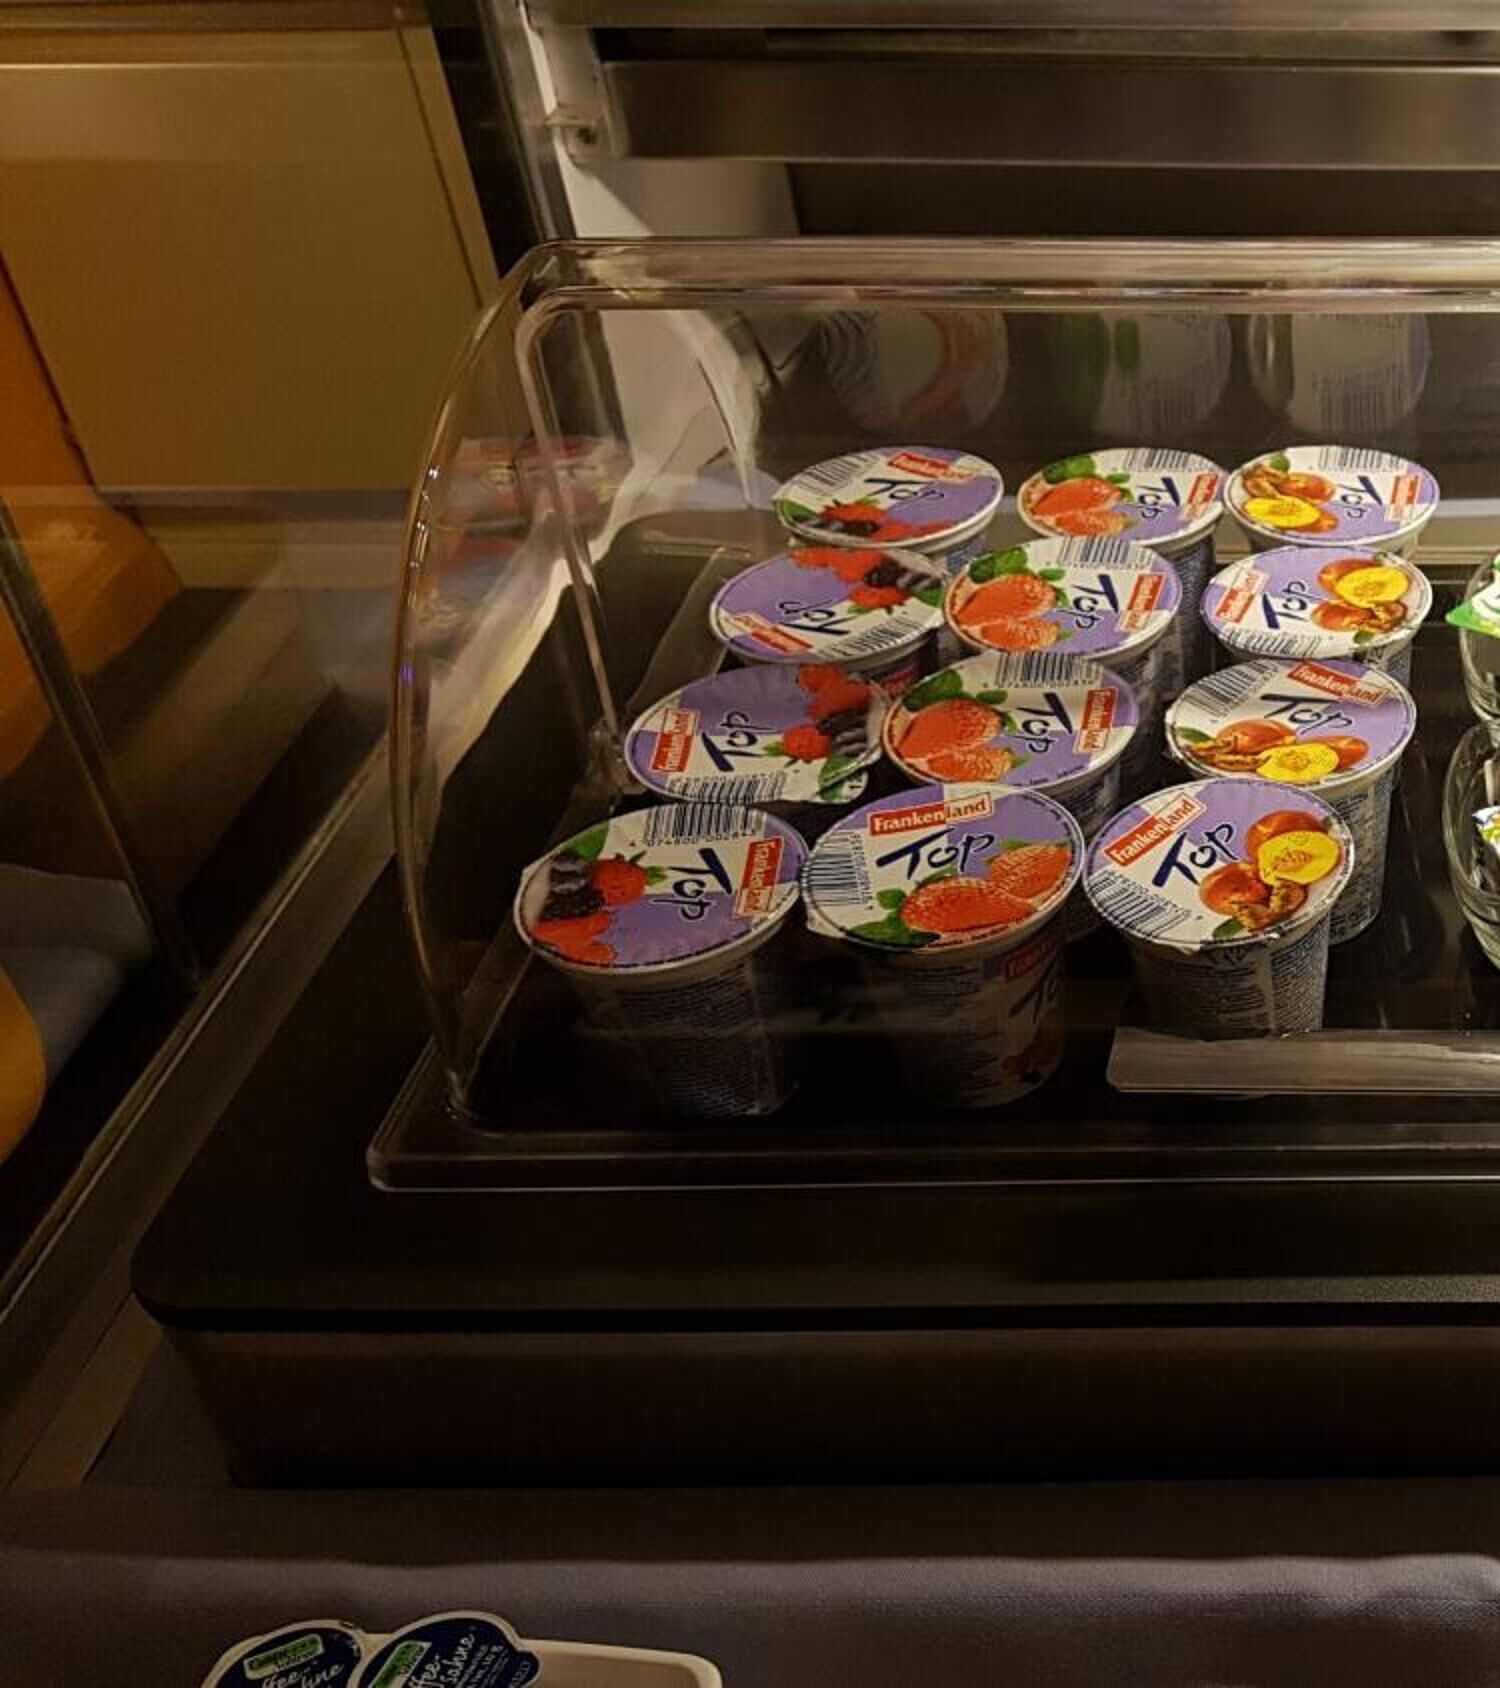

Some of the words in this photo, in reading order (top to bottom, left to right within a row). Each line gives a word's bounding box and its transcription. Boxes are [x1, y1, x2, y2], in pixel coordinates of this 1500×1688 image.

[864, 477, 945, 503] Top
[1136, 475, 1182, 520] Top
[1333, 475, 1384, 520] Top
[1058, 572, 1119, 631] Top
[1260, 580, 1317, 630] Top
[1295, 663, 1387, 702] Frankenland
[1015, 692, 1074, 755] Top
[1259, 692, 1353, 735] Top
[701, 710, 767, 772] Top
[872, 798, 989, 833] Frankenland
[1112, 799, 1197, 863] Frankenland
[874, 827, 995, 881] Top
[1151, 822, 1239, 888] Top
[651, 847, 733, 921] Top
